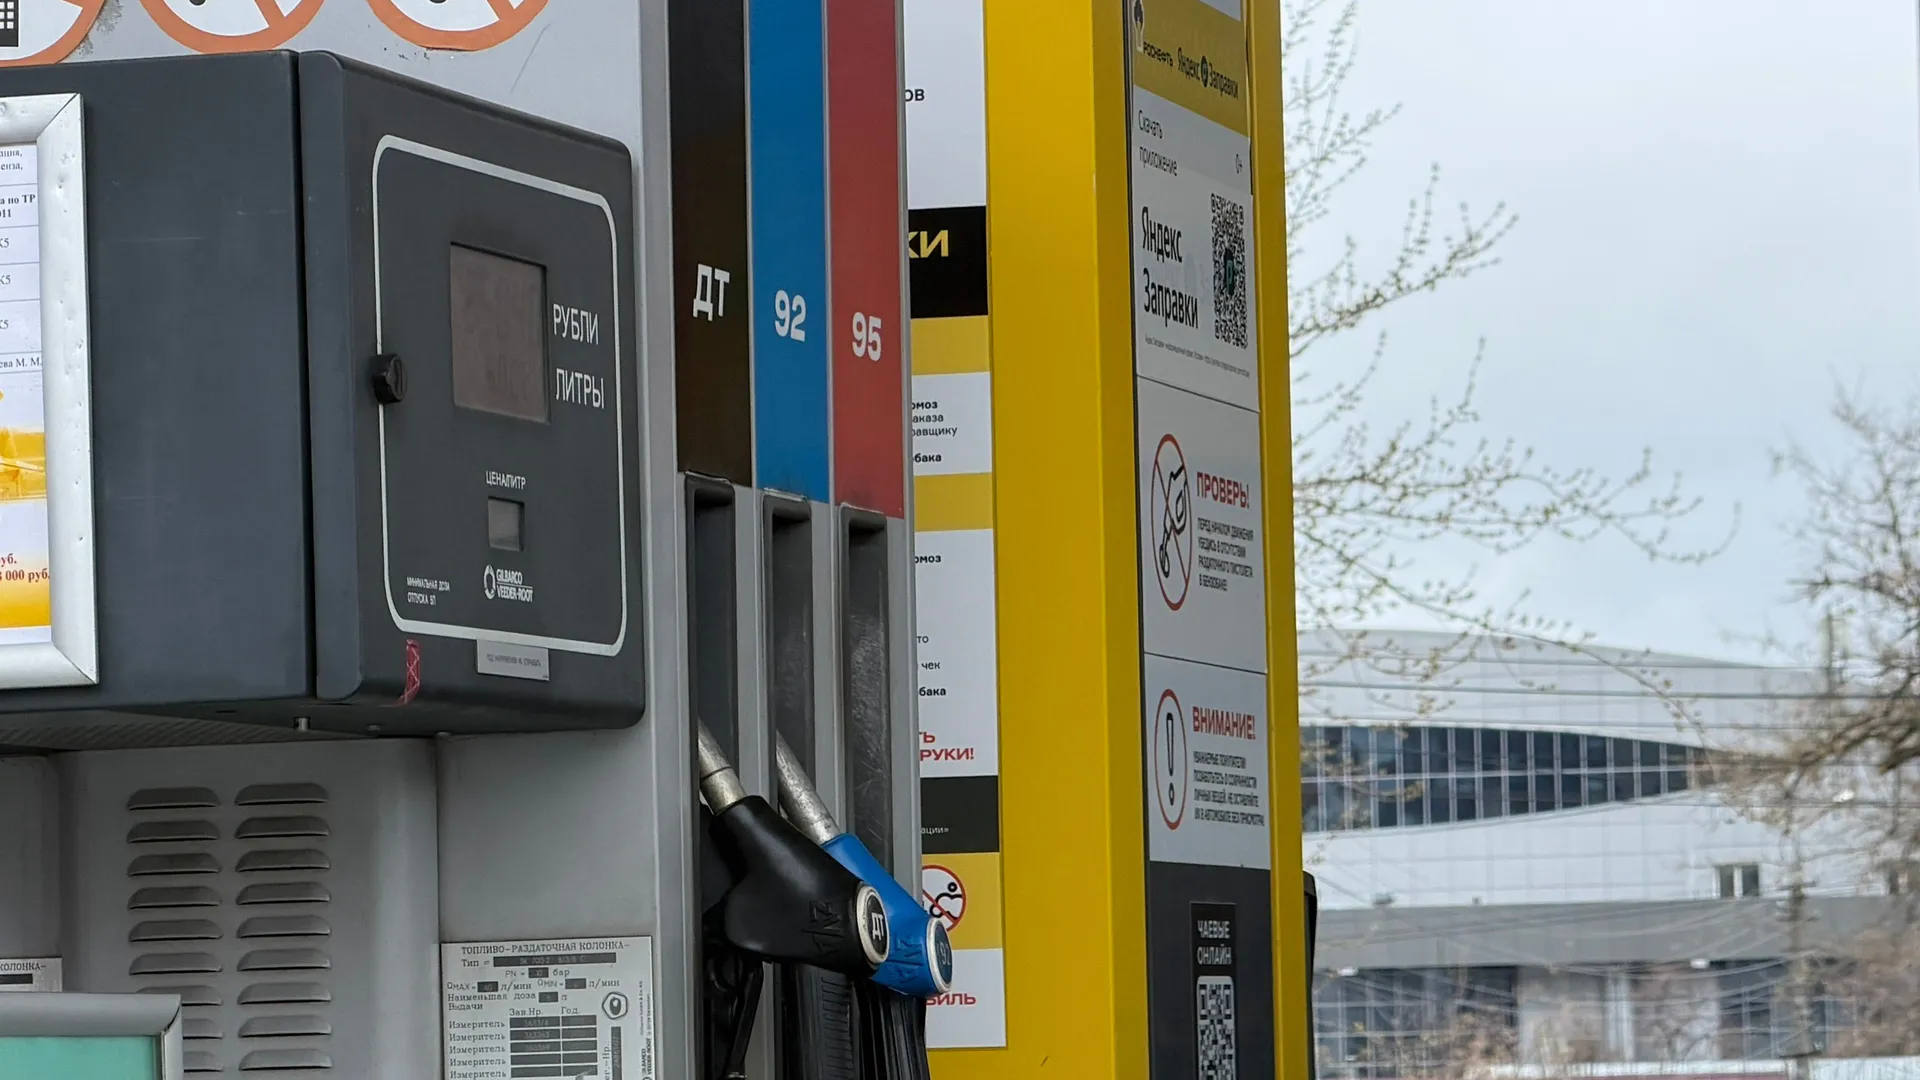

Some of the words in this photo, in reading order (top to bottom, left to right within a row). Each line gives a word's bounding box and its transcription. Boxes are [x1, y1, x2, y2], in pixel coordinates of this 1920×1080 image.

[1138, 109, 1163, 139] Скачать
[1139, 146, 1178, 176] приложение
[22, 194, 36, 203] ТР
[1141, 205, 1183, 263] Яндекс
[692, 263, 731, 322] ДТ
[1143, 267, 1199, 330] Заправки
[553, 303, 599, 345] РУБЛИ
[774, 290, 806, 342] 92
[852, 312, 882, 362] 95
[555, 368, 605, 409] ЛИТРЫ
[912, 453, 942, 463] бака
[1196, 471, 1250, 510] ПРОВЕРЬ!
[0, 553, 17, 567] уб.
[496, 568, 523, 585] GILBARCO
[921, 661, 941, 670] чек
[1192, 706, 1256, 741] ВНИМАНИЕ!
[920, 747, 975, 762] РУКИ!
[871, 912, 884, 941] ДТ
[1197, 920, 1231, 939] ЧАЕВЫЕ
[461, 958, 480, 968] Тип
[1197, 943, 1232, 965] ОНЛАЙН
[552, 968, 571, 978] бар
[513, 992, 536, 1000] доза
[449, 1020, 506, 1030] Измеритель
[449, 1033, 506, 1043] Измеритель
[449, 1045, 506, 1055] Измеритель
[449, 1058, 506, 1067] Измеритель
[449, 1070, 506, 1080] Измеритель
